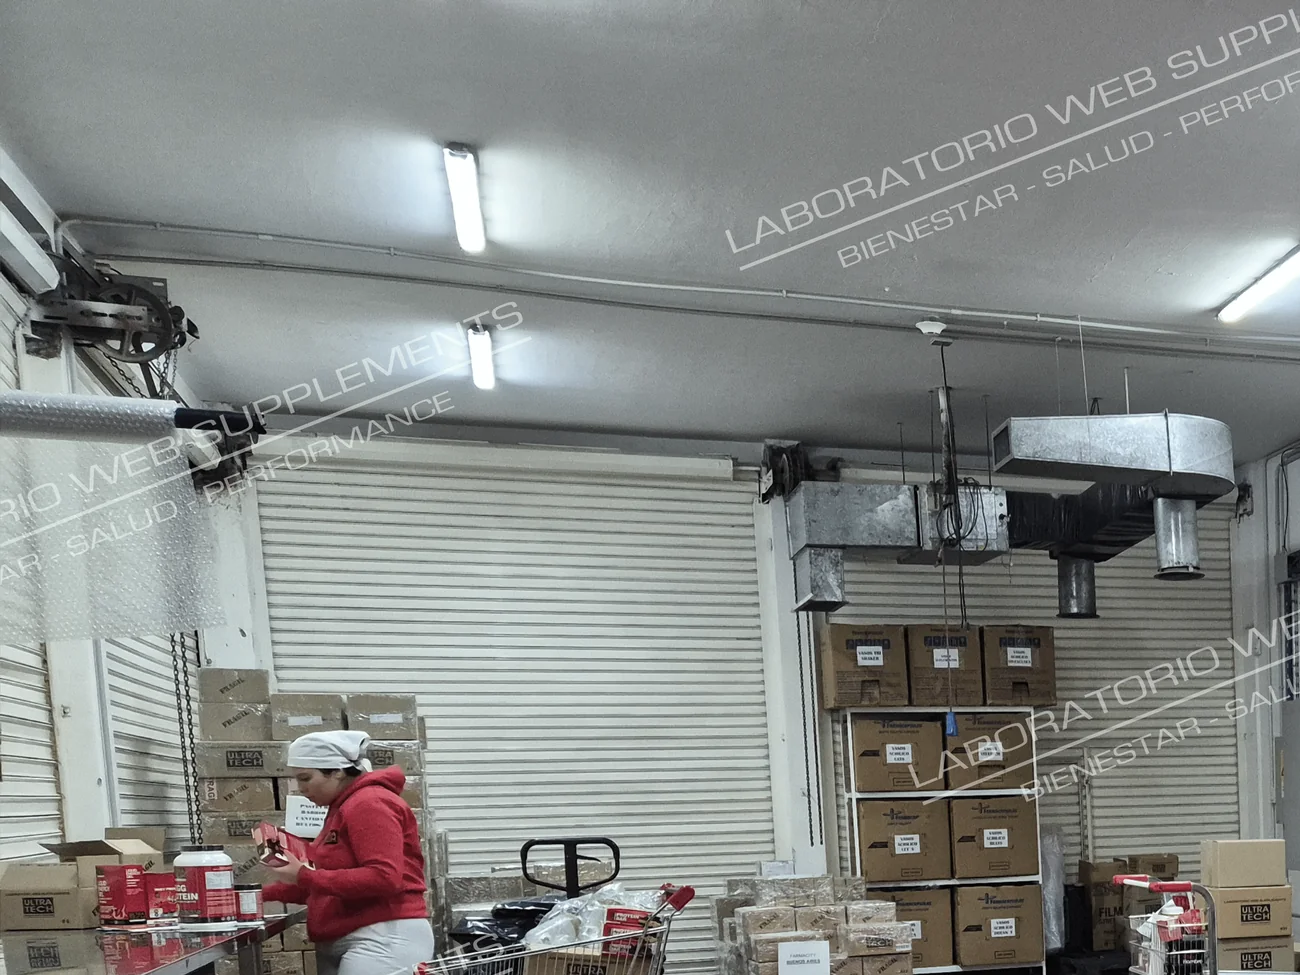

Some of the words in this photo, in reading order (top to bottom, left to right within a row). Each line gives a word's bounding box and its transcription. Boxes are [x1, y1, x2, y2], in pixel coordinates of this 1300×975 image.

[218, 677, 245, 694] FRAGIL
[221, 708, 249, 728] FRAGIL
[176, 893, 199, 901] TEIN
[24, 898, 52, 906] ULTRA
[1242, 905, 1270, 914] ULTRA
[1242, 913, 1270, 921] TECH
[1242, 952, 1270, 961] ULTRA
[877, 957, 898, 974] FRAGIL
[1242, 960, 1271, 969] TECH
